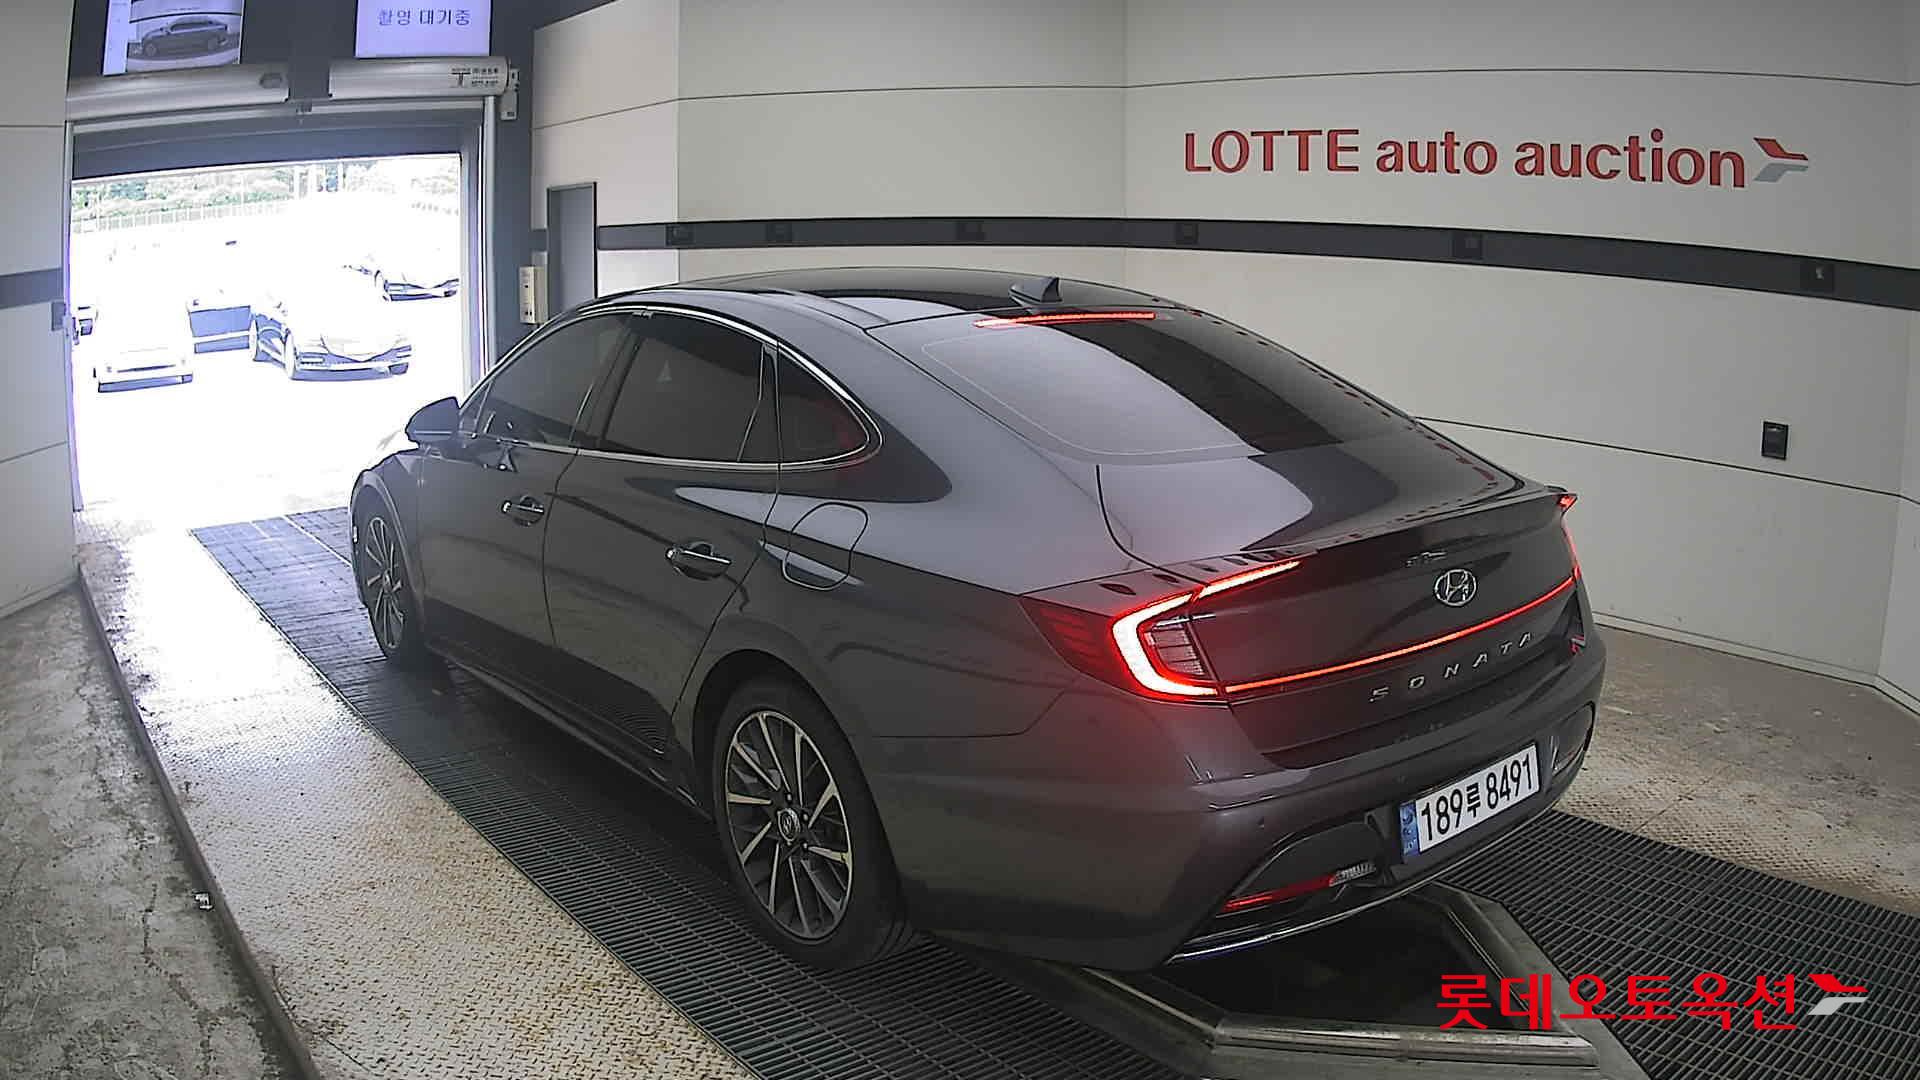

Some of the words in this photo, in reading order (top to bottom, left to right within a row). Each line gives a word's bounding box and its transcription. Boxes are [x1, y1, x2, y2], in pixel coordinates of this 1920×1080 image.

[419, 9, 471, 26] 대기중
[1185, 129, 1360, 174] LOTTE
[1376, 131, 1498, 176] auto
[1514, 128, 1745, 188] auction
[1369, 632, 1532, 703] SONATA
[1420, 782, 1481, 841] 189루
[1485, 752, 1533, 810] 8491
